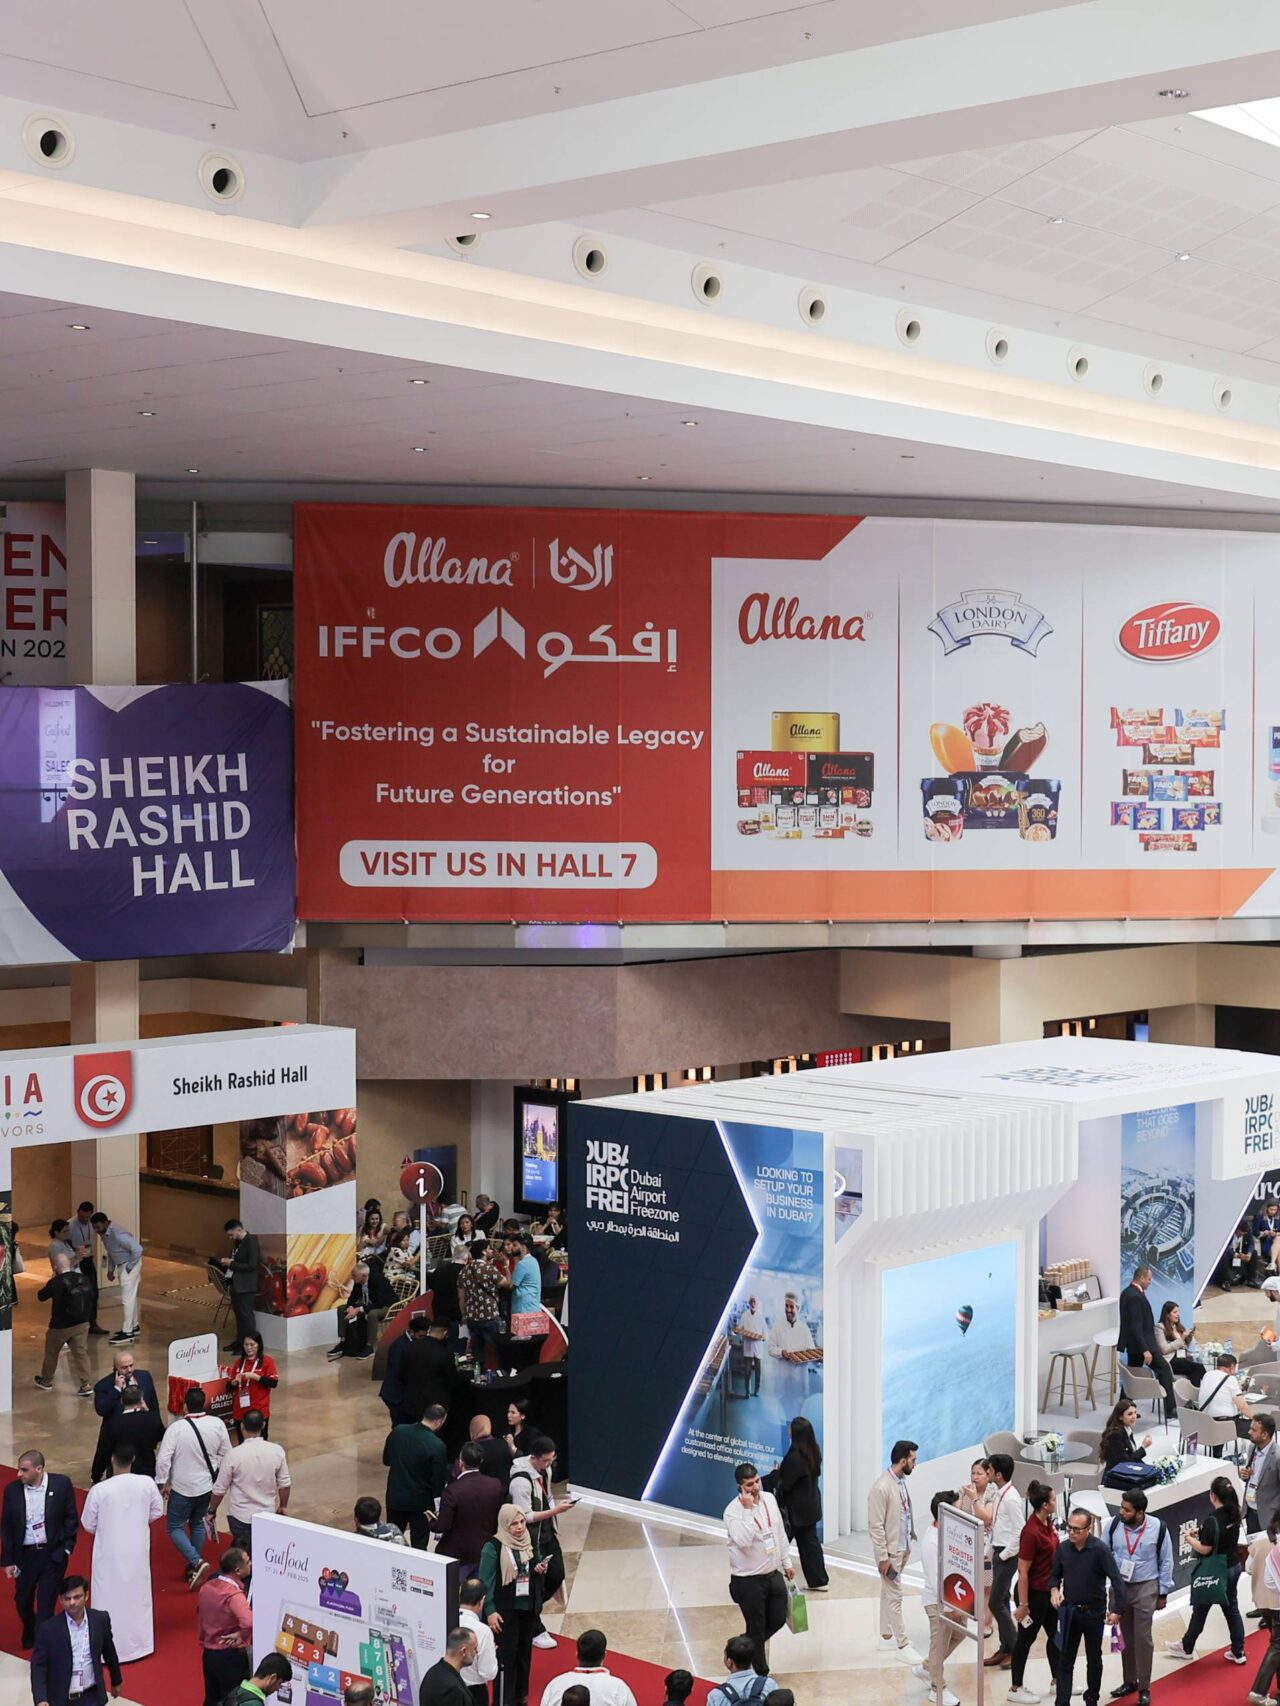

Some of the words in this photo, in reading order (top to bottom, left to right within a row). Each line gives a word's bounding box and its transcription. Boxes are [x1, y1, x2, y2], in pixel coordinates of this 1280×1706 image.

[383, 531, 514, 588] Allana
[738, 592, 867, 645] Allana
[955, 607, 1027, 624] LONDON
[971, 620, 1011, 629] DAIRY
[319, 625, 461, 660] IFFCO
[1133, 617, 1212, 649] Tiffany
[311, 721, 435, 747] "Fostering
[443, 727, 457, 742] a
[465, 723, 609, 744] Sustainable
[617, 725, 704, 750] Legacy
[482, 755, 515, 773] for
[753, 762, 789, 778] Allana
[67, 753, 248, 800] SHEIKH
[376, 784, 454, 804] Future
[462, 784, 622, 806] Generations"
[67, 801, 250, 850] RASHID
[132, 849, 255, 896] HALL
[360, 851, 437, 876] VISIT
[447, 853, 487, 877] US
[498, 853, 525, 877] IN
[537, 854, 613, 878] HALL
[621, 854, 637, 878] 7
[173, 1071, 222, 1095] Sheikh
[228, 1068, 275, 1090] Rashid
[281, 1065, 308, 1084] Hall
[1136, 1115, 1156, 1130] THAT
[1158, 1111, 1179, 1126] GOES
[1136, 1126, 1169, 1143] BEYOND
[630, 1169, 662, 1187] Dubai
[757, 1165, 798, 1181] LOOKING
[800, 1171, 813, 1183] TO
[630, 1185, 666, 1206] Airport
[753, 1178, 785, 1192] SETUP
[786, 1183, 813, 1196] YOUR
[767, 1193, 813, 1210] BUSINESS
[630, 1201, 679, 1222] Freezone
[766, 1206, 776, 1217] IN
[778, 1208, 813, 1223] DUBAI?
[175, 1341, 210, 1362] Gulfood
[211, 1391, 233, 1404] LANYA
[685, 1438, 716, 1450] customized
[716, 1444, 733, 1454] office
[688, 1428, 695, 1436] At
[696, 1428, 705, 1438] the
[705, 1432, 723, 1442] center
[724, 1435, 730, 1444] of
[730, 1437, 748, 1447] global
[681, 1446, 706, 1457] designed
[707, 1451, 714, 1459] to
[714, 1453, 734, 1464] elevate
[265, 1541, 309, 1575] Gulfood
[948, 1545, 974, 1562] REGISTER
[287, 1571, 297, 1580] FEB
[287, 1618, 294, 1628] 4
[301, 1623, 308, 1634] 5
[316, 1630, 323, 1640] 6
[281, 1637, 288, 1647] 1
[297, 1643, 304, 1653] 2
[313, 1649, 320, 1660] 3
[373, 1639, 380, 1649] 8
[374, 1652, 381, 1662] 7
[312, 1667, 319, 1677] 1
[328, 1671, 335, 1682] 2
[345, 1676, 352, 1687] 3
[376, 1665, 383, 1676] 6
